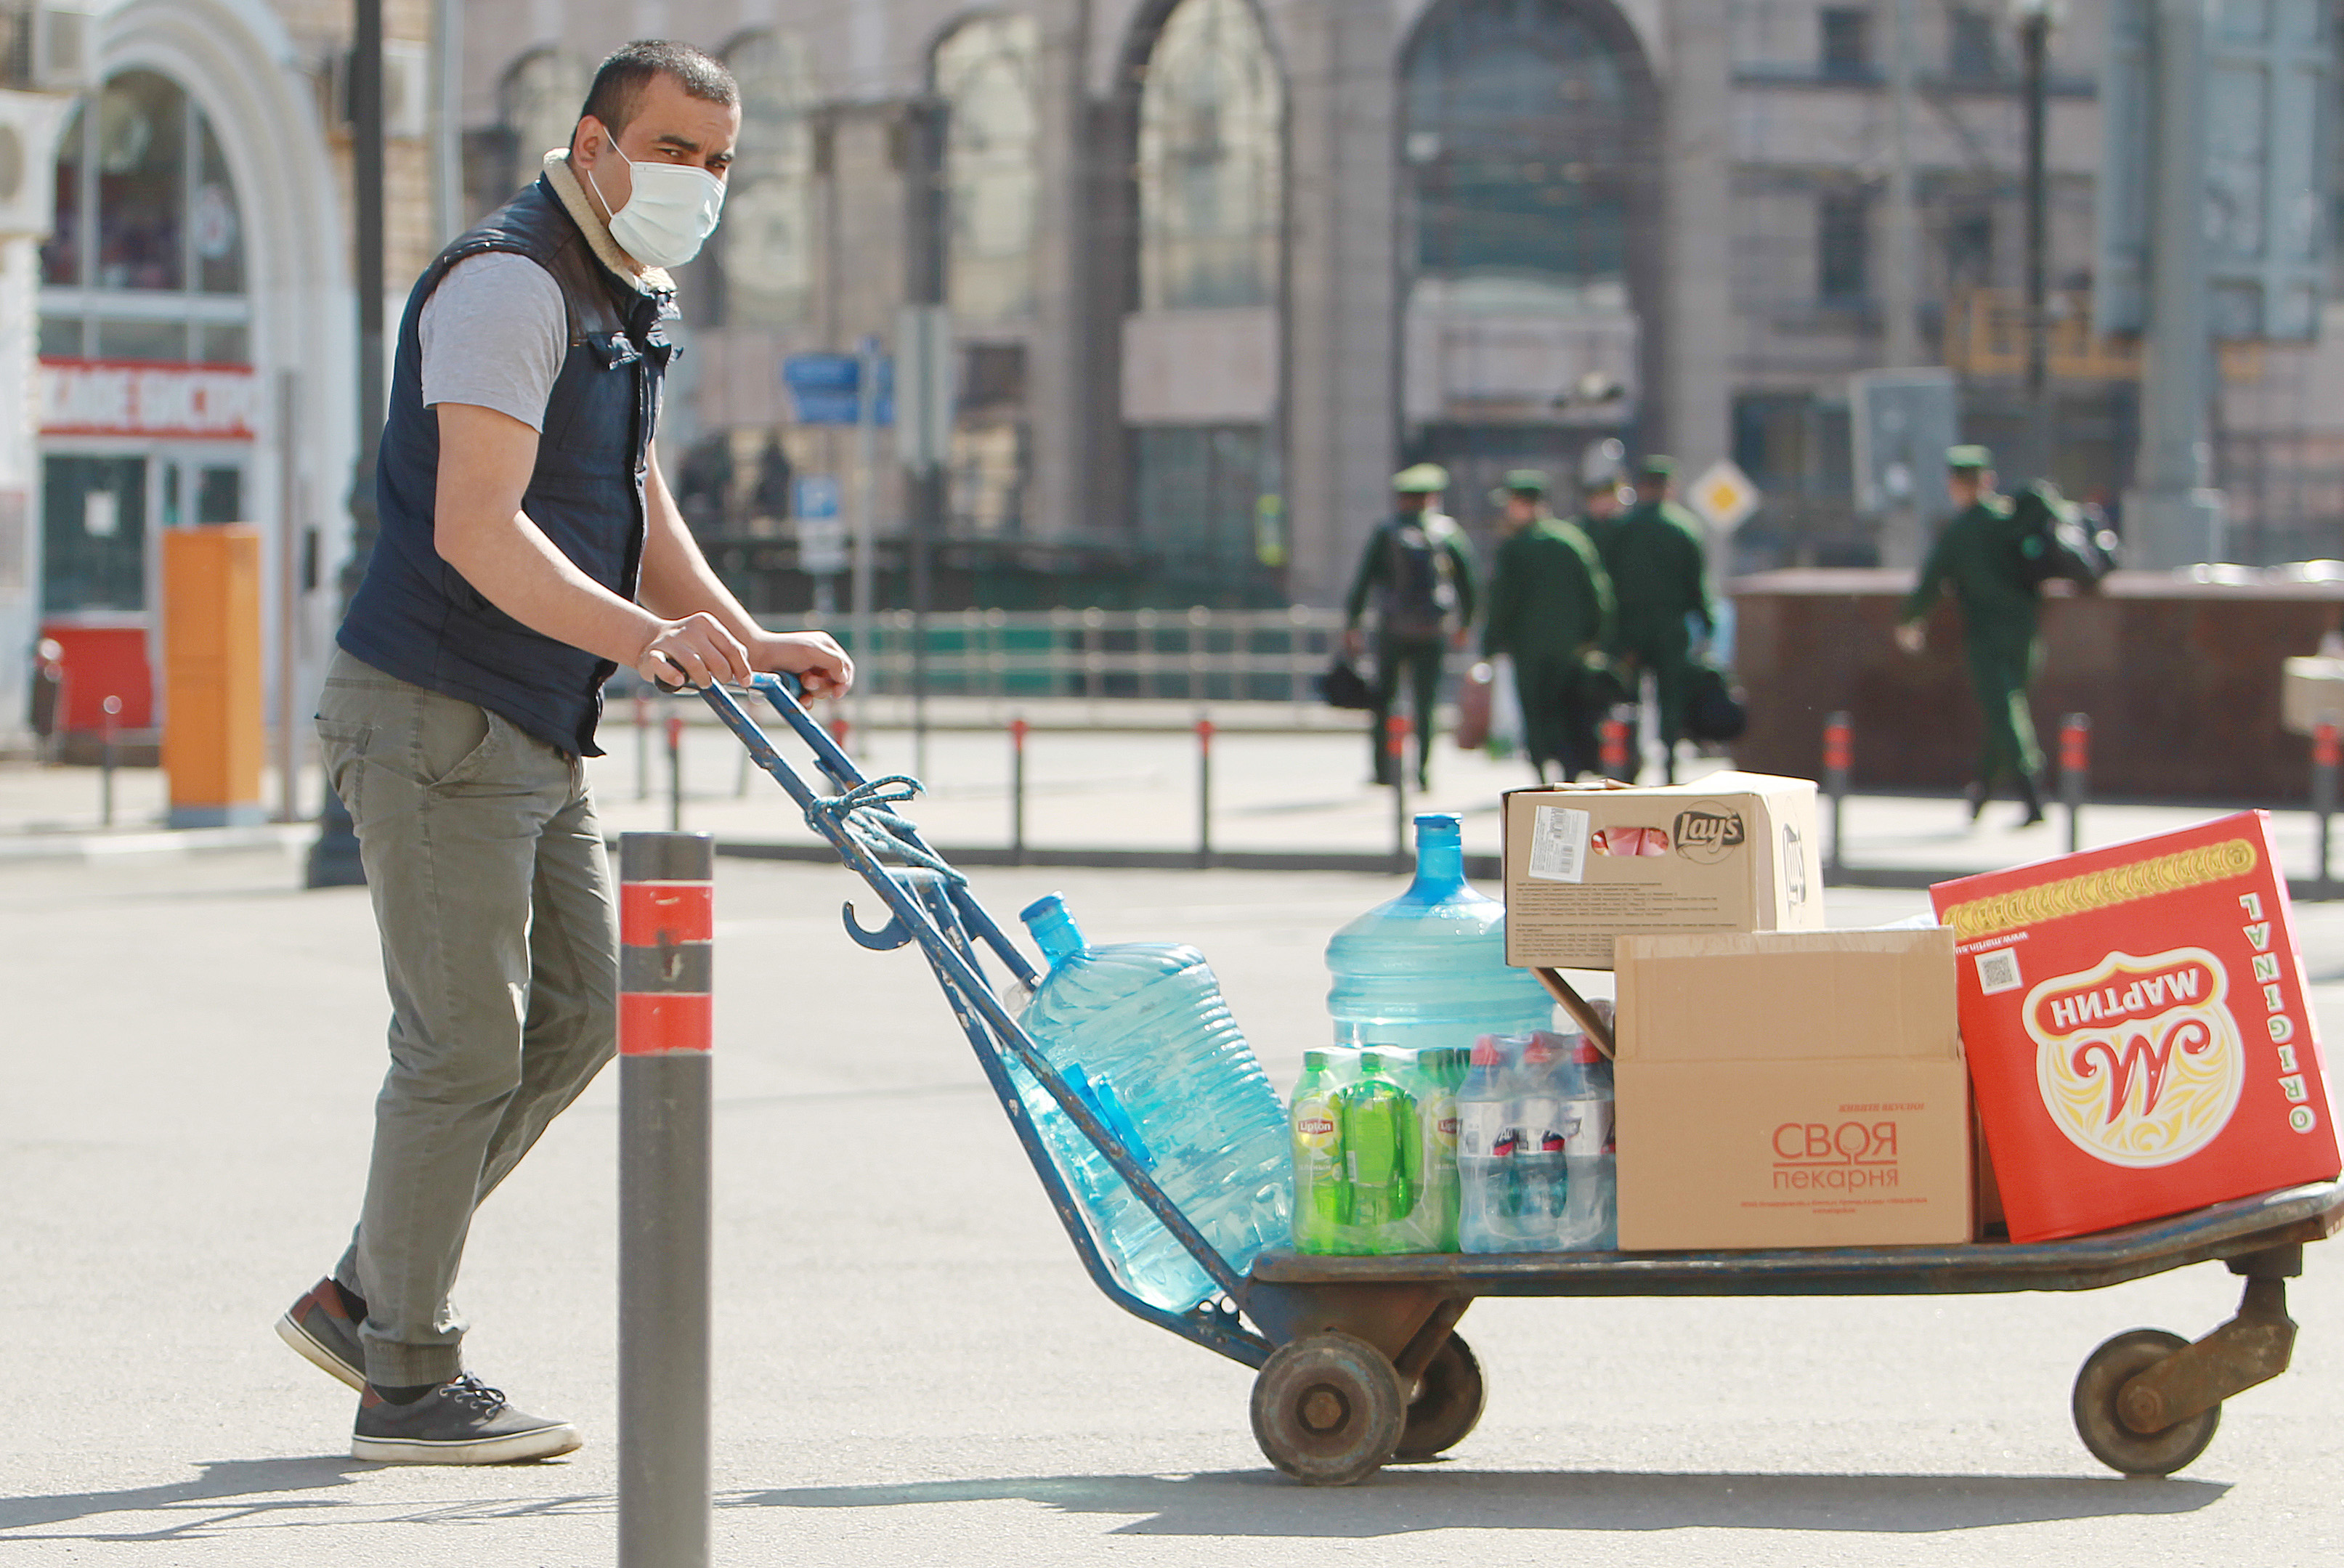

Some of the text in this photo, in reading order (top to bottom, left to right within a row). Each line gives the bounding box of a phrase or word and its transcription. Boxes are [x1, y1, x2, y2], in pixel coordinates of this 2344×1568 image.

[1676, 813, 1740, 854] Lay's
[1955, 931, 2028, 954] www.martin.su
[2050, 967, 2199, 1028] МАРТИН
[2239, 892, 2316, 1134] ORIGINAL
[1300, 1121, 1331, 1133] Lipton
[1772, 1121, 1897, 1162] СВОЯ
[1772, 1168, 1899, 1193] пекарня
